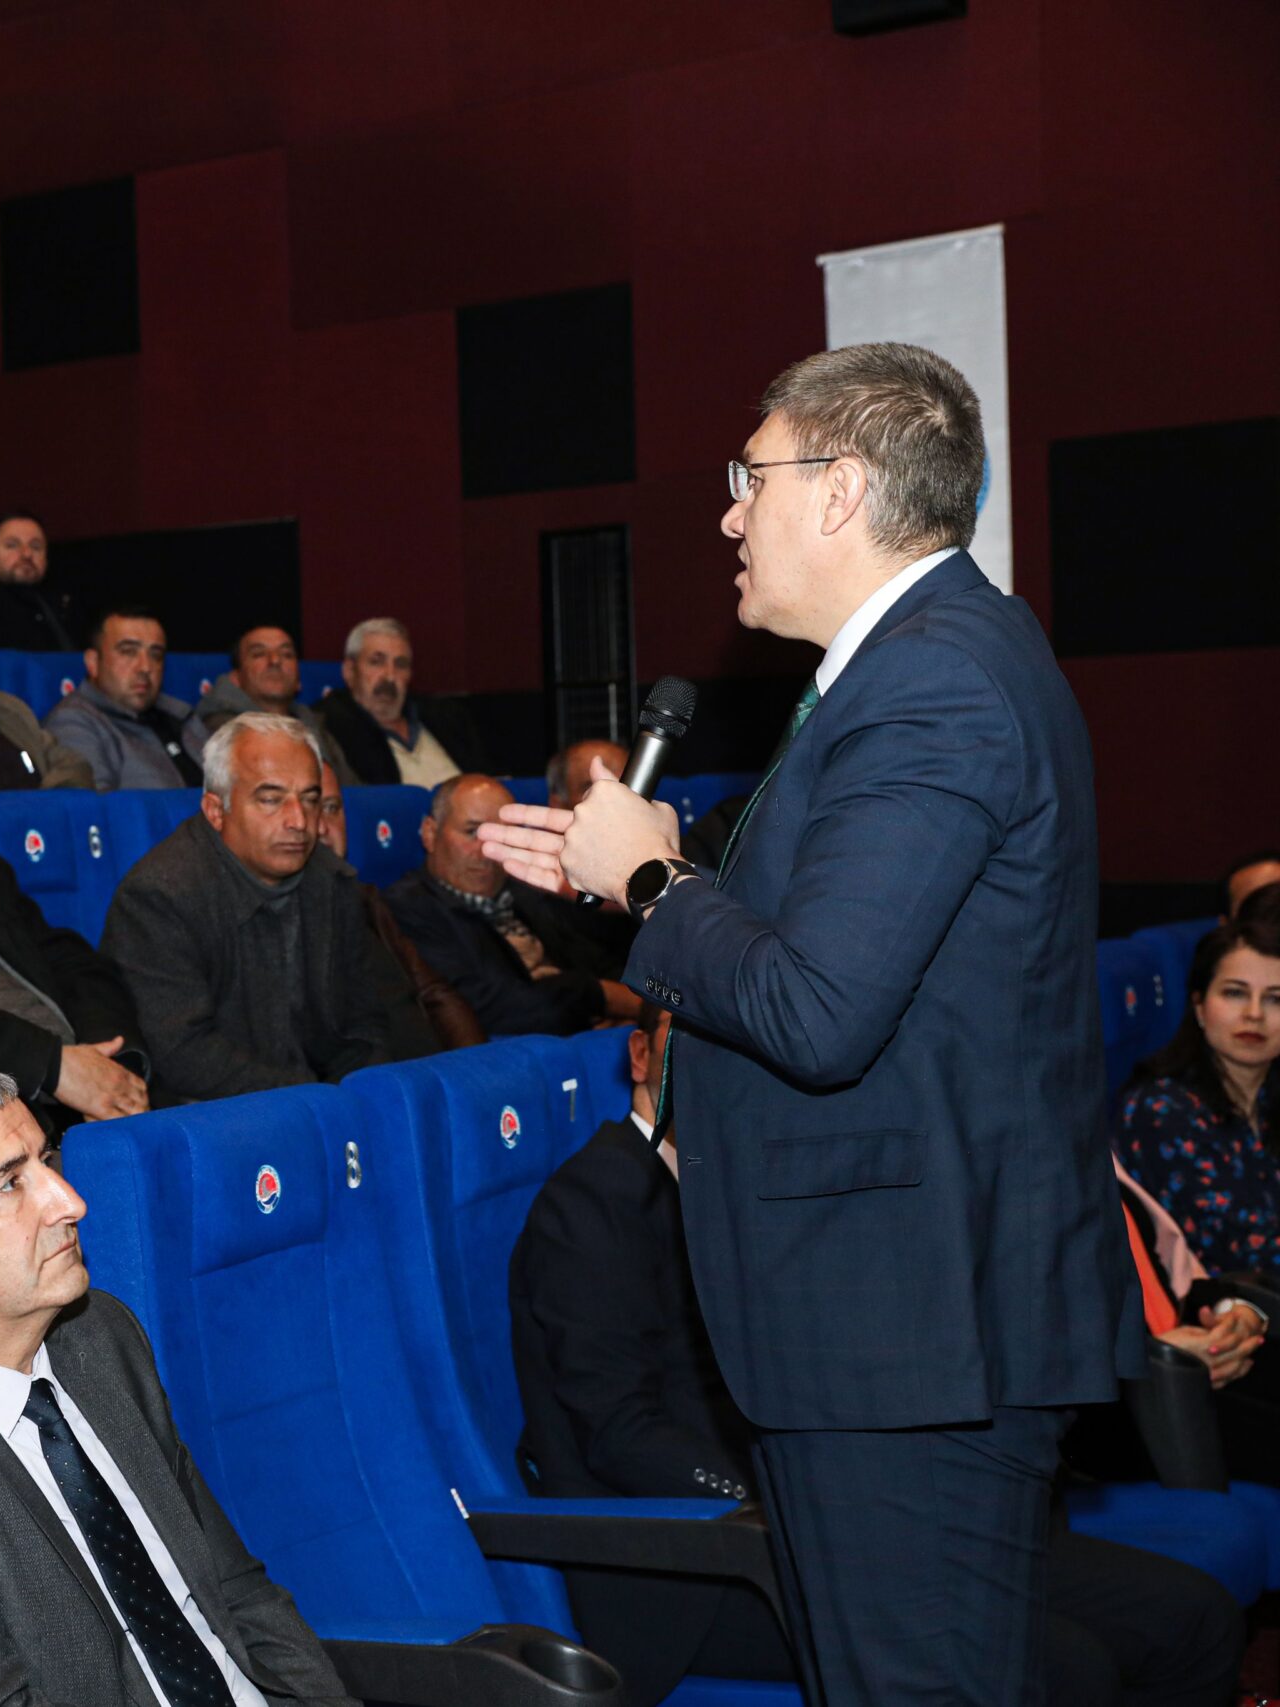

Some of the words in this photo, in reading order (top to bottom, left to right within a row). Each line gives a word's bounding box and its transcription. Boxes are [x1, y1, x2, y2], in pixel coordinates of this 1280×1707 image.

[88, 825, 102, 859] 6
[562, 1078, 578, 1123] 7
[346, 1141, 362, 1188] 8
